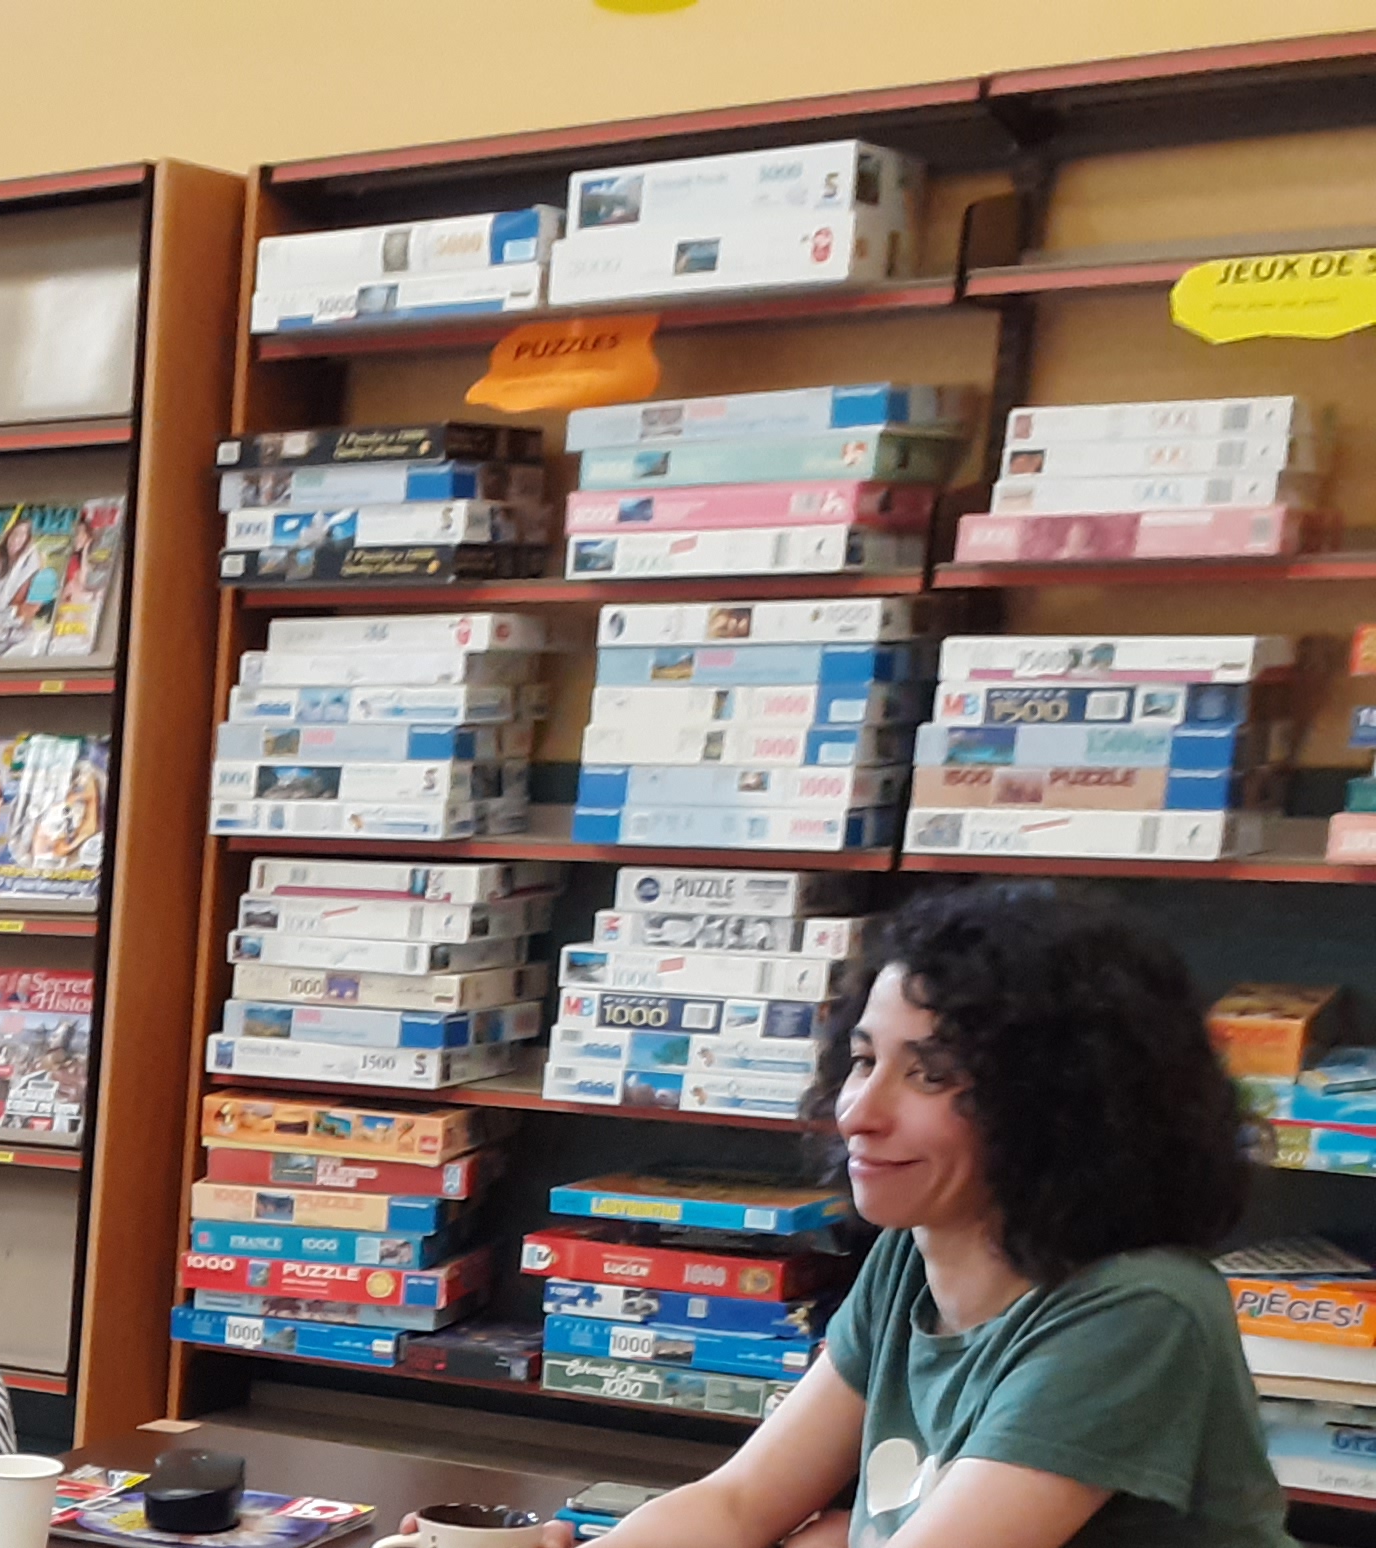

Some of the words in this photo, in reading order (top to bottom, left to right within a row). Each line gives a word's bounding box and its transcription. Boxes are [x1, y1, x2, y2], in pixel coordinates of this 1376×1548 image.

[1217, 258, 1300, 286] JEUX
[1311, 255, 1352, 278] DE
[513, 332, 620, 362] PUZZLES
[992, 699, 1069, 723] 1500
[944, 768, 992, 788] 1500
[1048, 767, 1137, 788] PUZZLE
[672, 876, 736, 901] PUZZLE
[564, 995, 594, 1017] MB
[603, 1004, 670, 1027] 1000
[360, 1054, 397, 1071] 1500
[301, 1237, 339, 1251] 1000
[186, 1256, 236, 1271] 1000
[282, 1262, 360, 1281] PUZZLE
[227, 1324, 262, 1342] 1000
[610, 1333, 652, 1354] 1000
[601, 1378, 643, 1398] 1000
